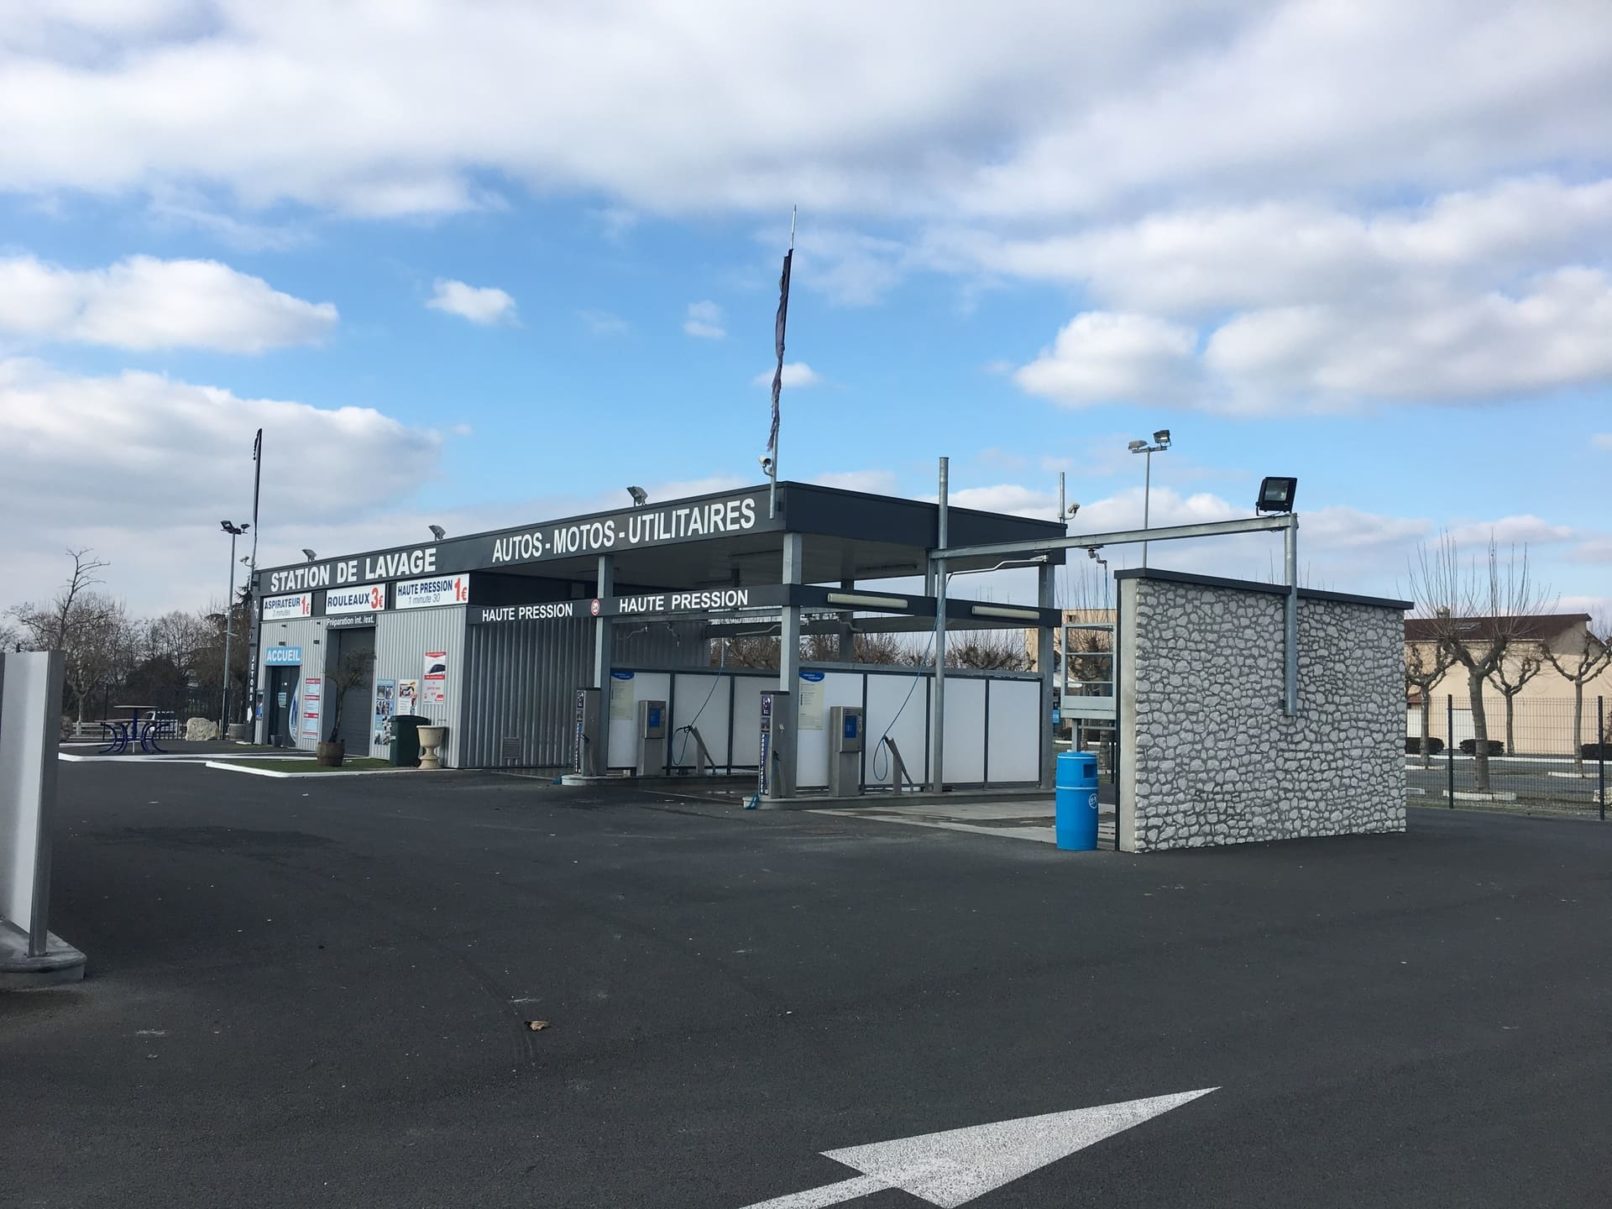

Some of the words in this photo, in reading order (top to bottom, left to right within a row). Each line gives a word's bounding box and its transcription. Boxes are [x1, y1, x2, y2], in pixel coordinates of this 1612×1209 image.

[628, 498, 756, 544] UTILITAIRES
[270, 564, 330, 592] STATION
[337, 560, 358, 584] DE
[365, 548, 437, 580] LAVAGE
[397, 583, 419, 596] HAUTE
[420, 579, 453, 594] PRESSION
[264, 597, 300, 610] ASPIRATEUR
[327, 593, 370, 607] ROULEAUX
[619, 596, 665, 613] HAUTE
[671, 589, 749, 610] PRESSION
[482, 608, 515, 622] HAUTE
[518, 603, 573, 619] PRESSION
[266, 650, 301, 662] ACCUEIL
